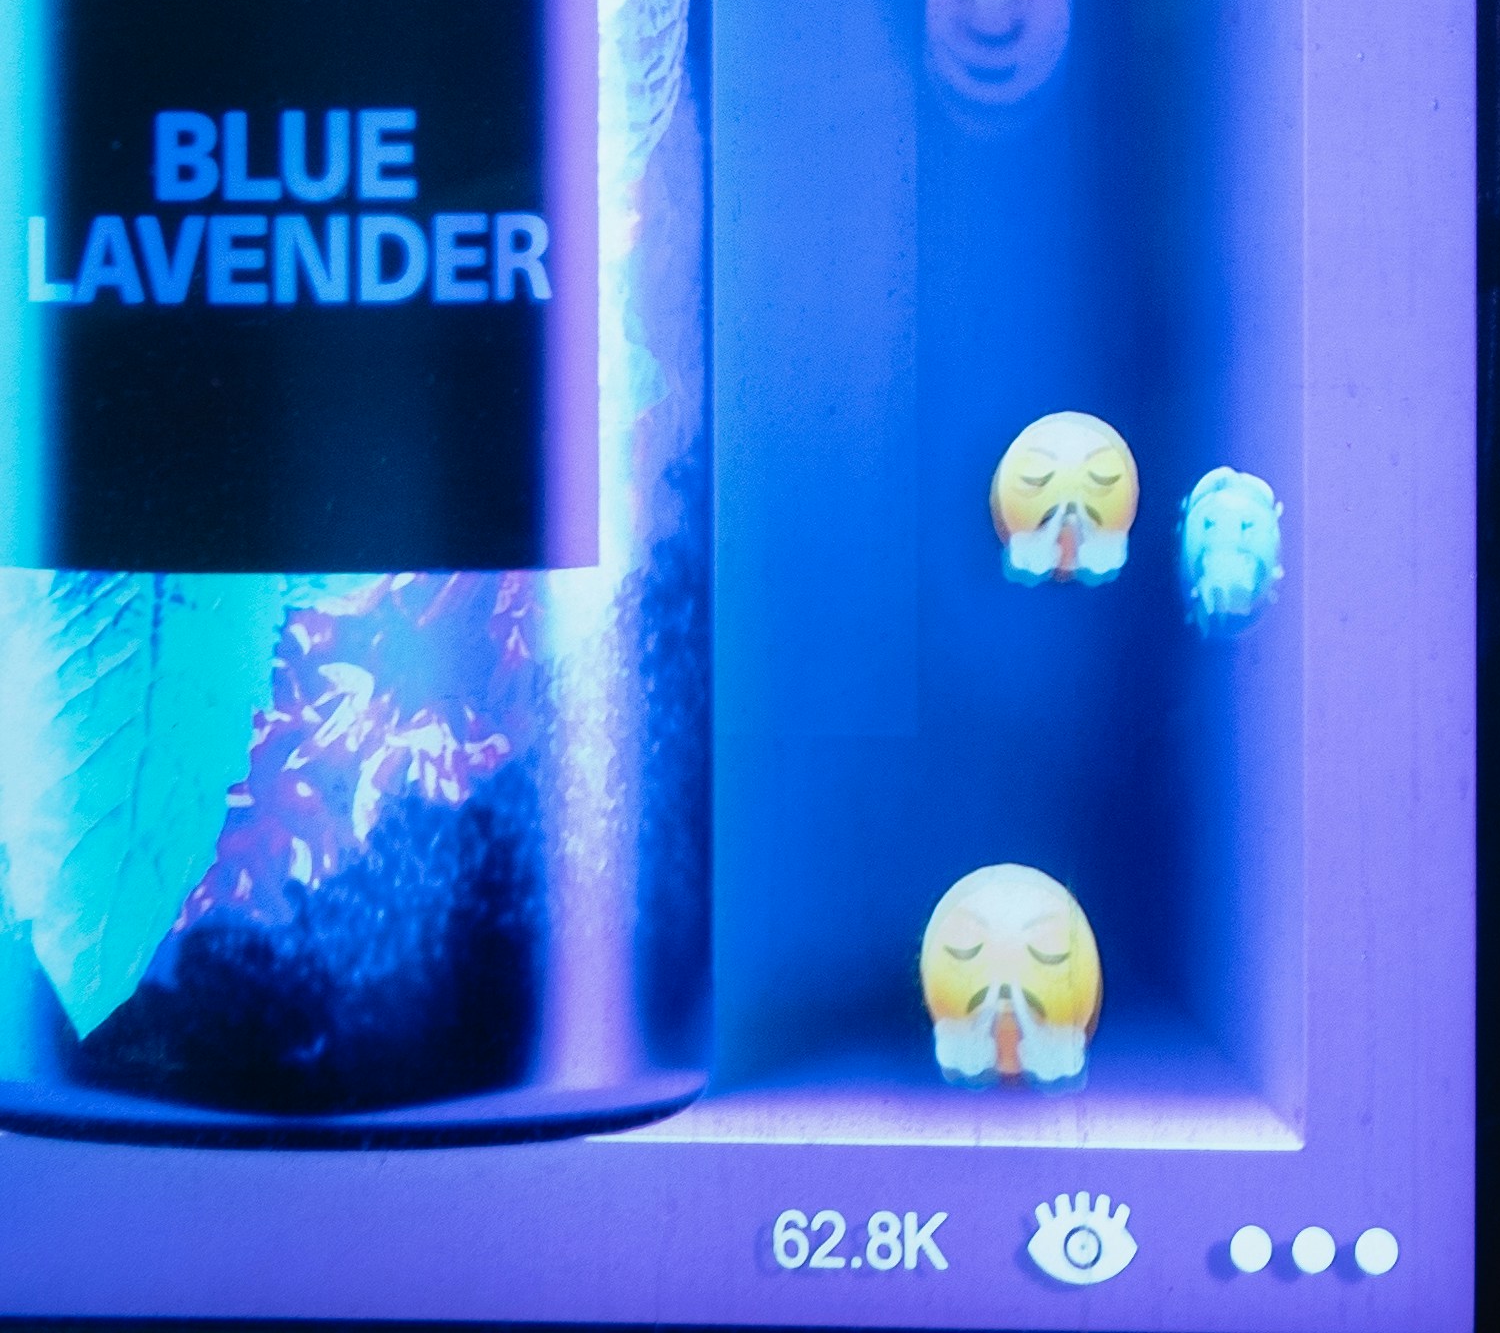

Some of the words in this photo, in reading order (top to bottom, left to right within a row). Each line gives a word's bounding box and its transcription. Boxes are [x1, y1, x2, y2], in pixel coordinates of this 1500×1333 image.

[153, 108, 418, 202] BLUE
[27, 212, 553, 305] LAVENDER
[772, 1208, 949, 1271] 62.8K
